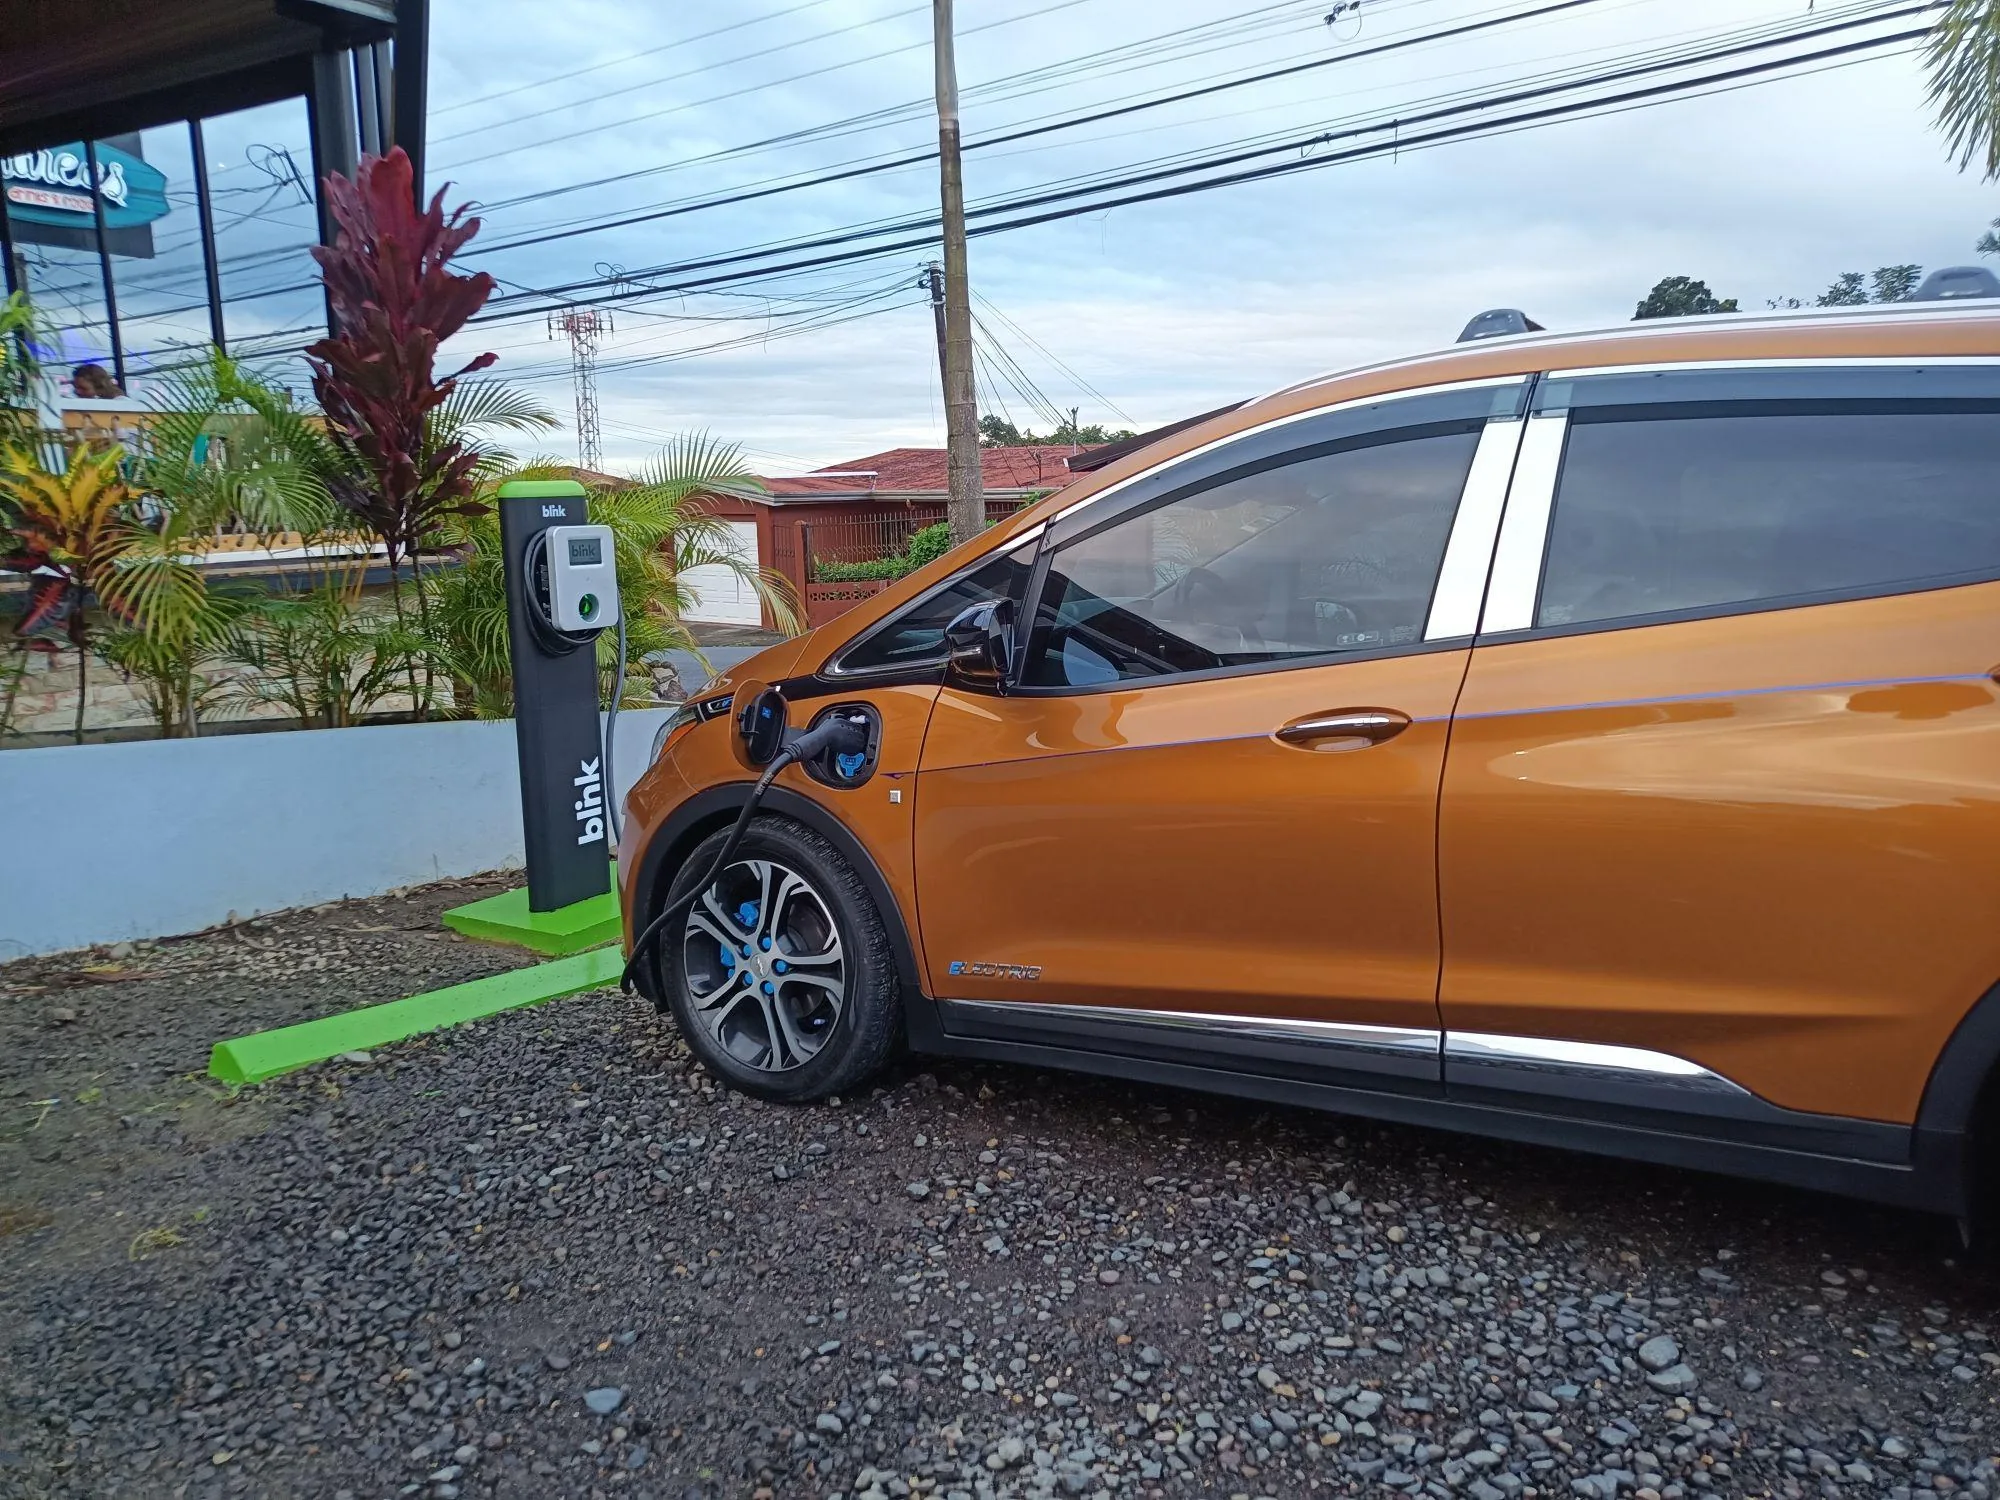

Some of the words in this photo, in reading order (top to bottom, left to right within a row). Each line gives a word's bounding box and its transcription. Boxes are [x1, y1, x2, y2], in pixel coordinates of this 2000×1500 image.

[542, 505, 566, 517] blink
[571, 544, 595, 557] blink
[573, 756, 604, 845] blink
[949, 961, 1042, 980] ELECTRIC
